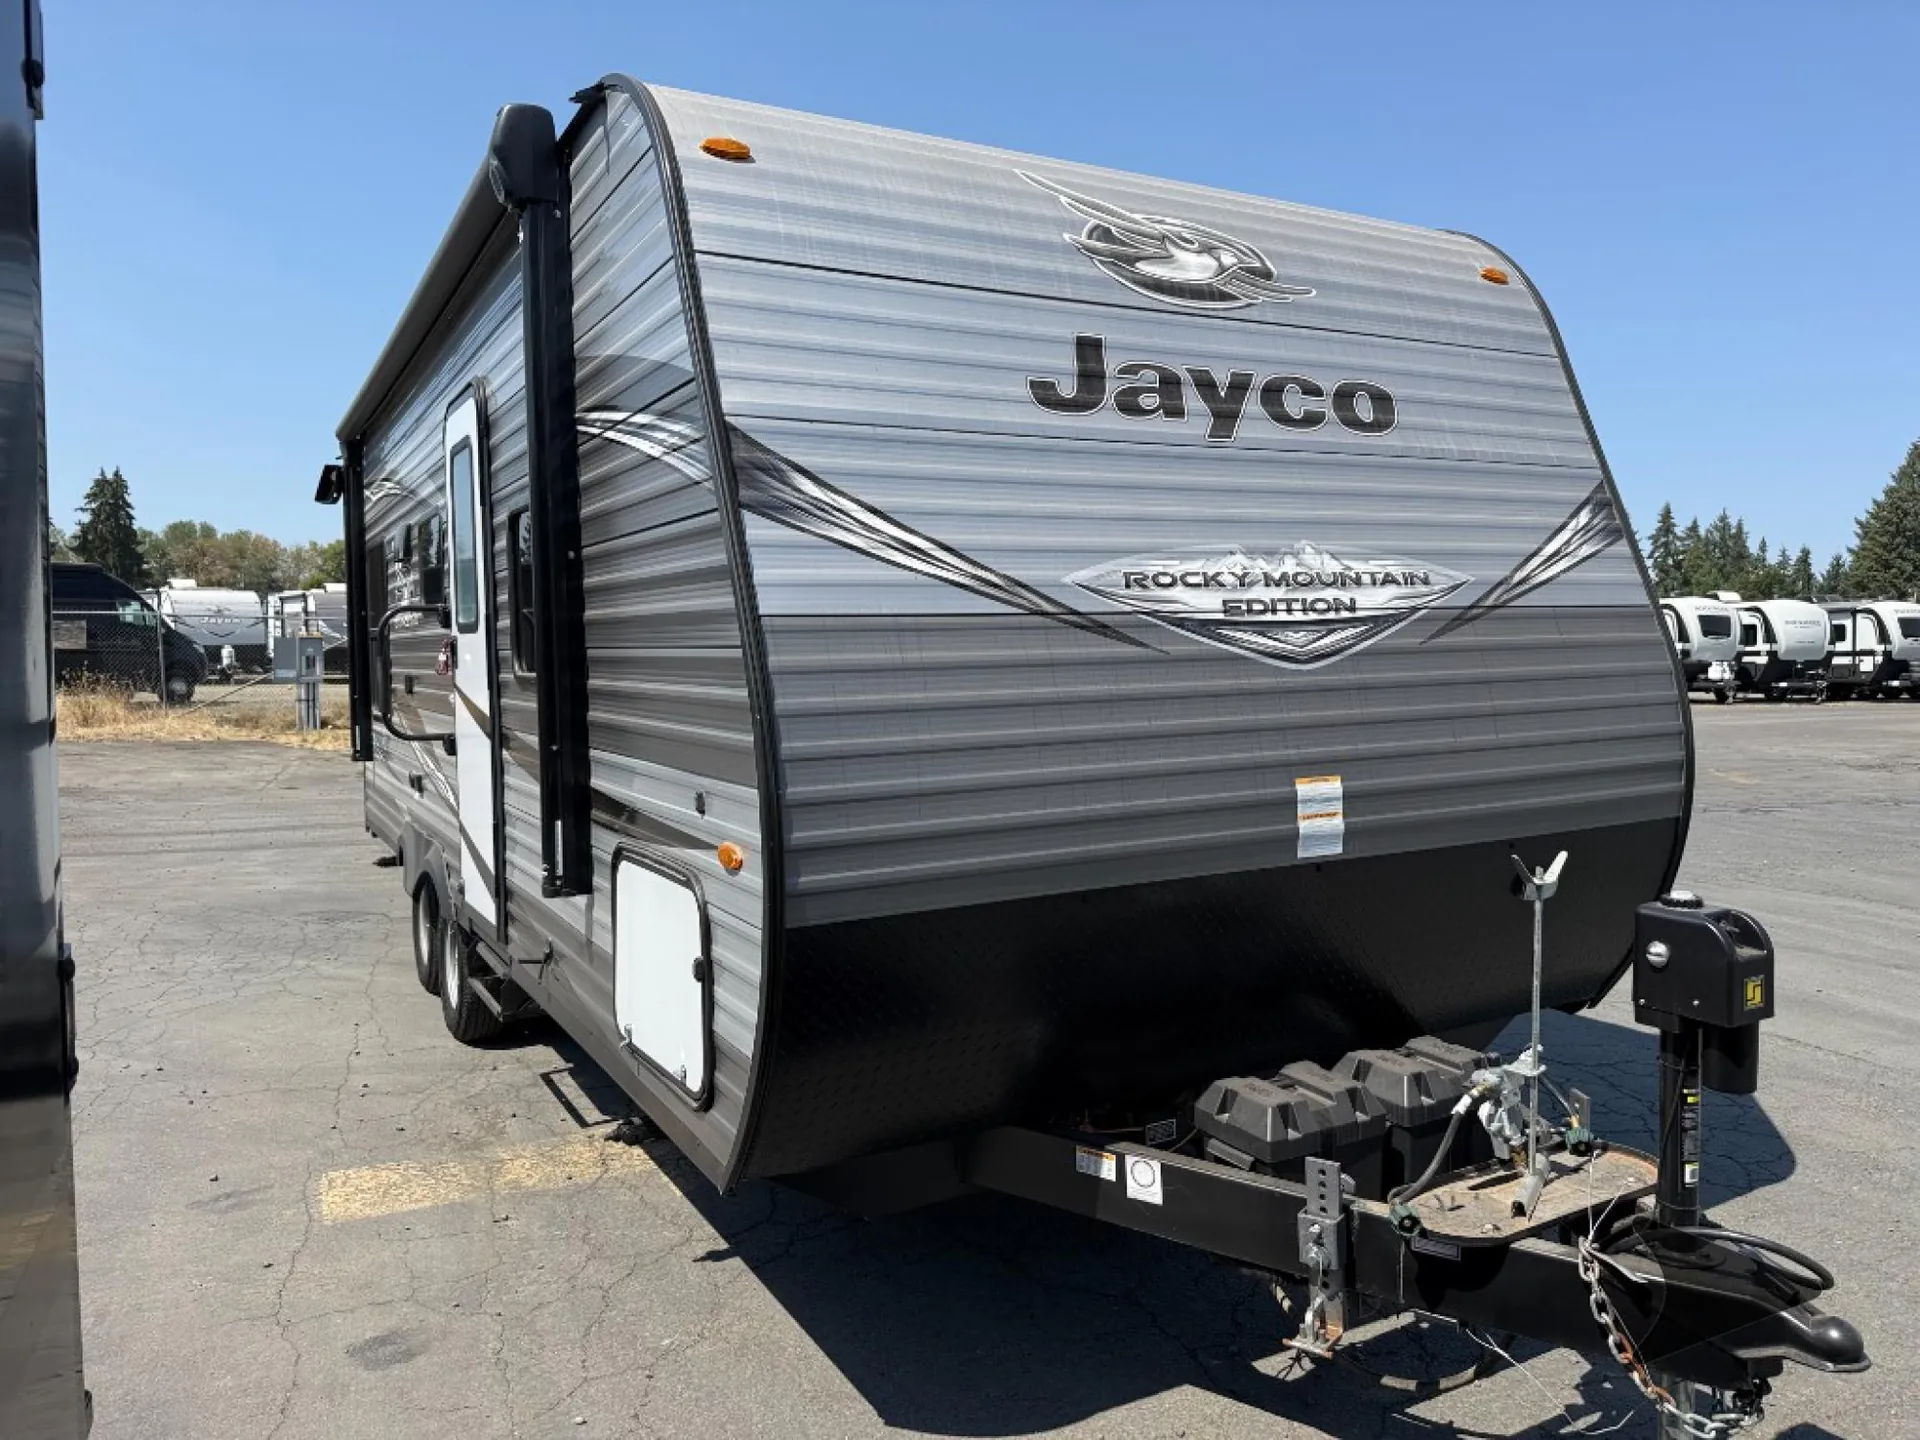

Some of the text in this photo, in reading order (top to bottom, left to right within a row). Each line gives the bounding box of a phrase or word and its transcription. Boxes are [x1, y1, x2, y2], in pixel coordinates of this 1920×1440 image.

[1026, 332, 1398, 442] Jayco
[1122, 570, 1431, 589] ROCKY MOUNTAIN
[1222, 597, 1356, 616] EDITION
